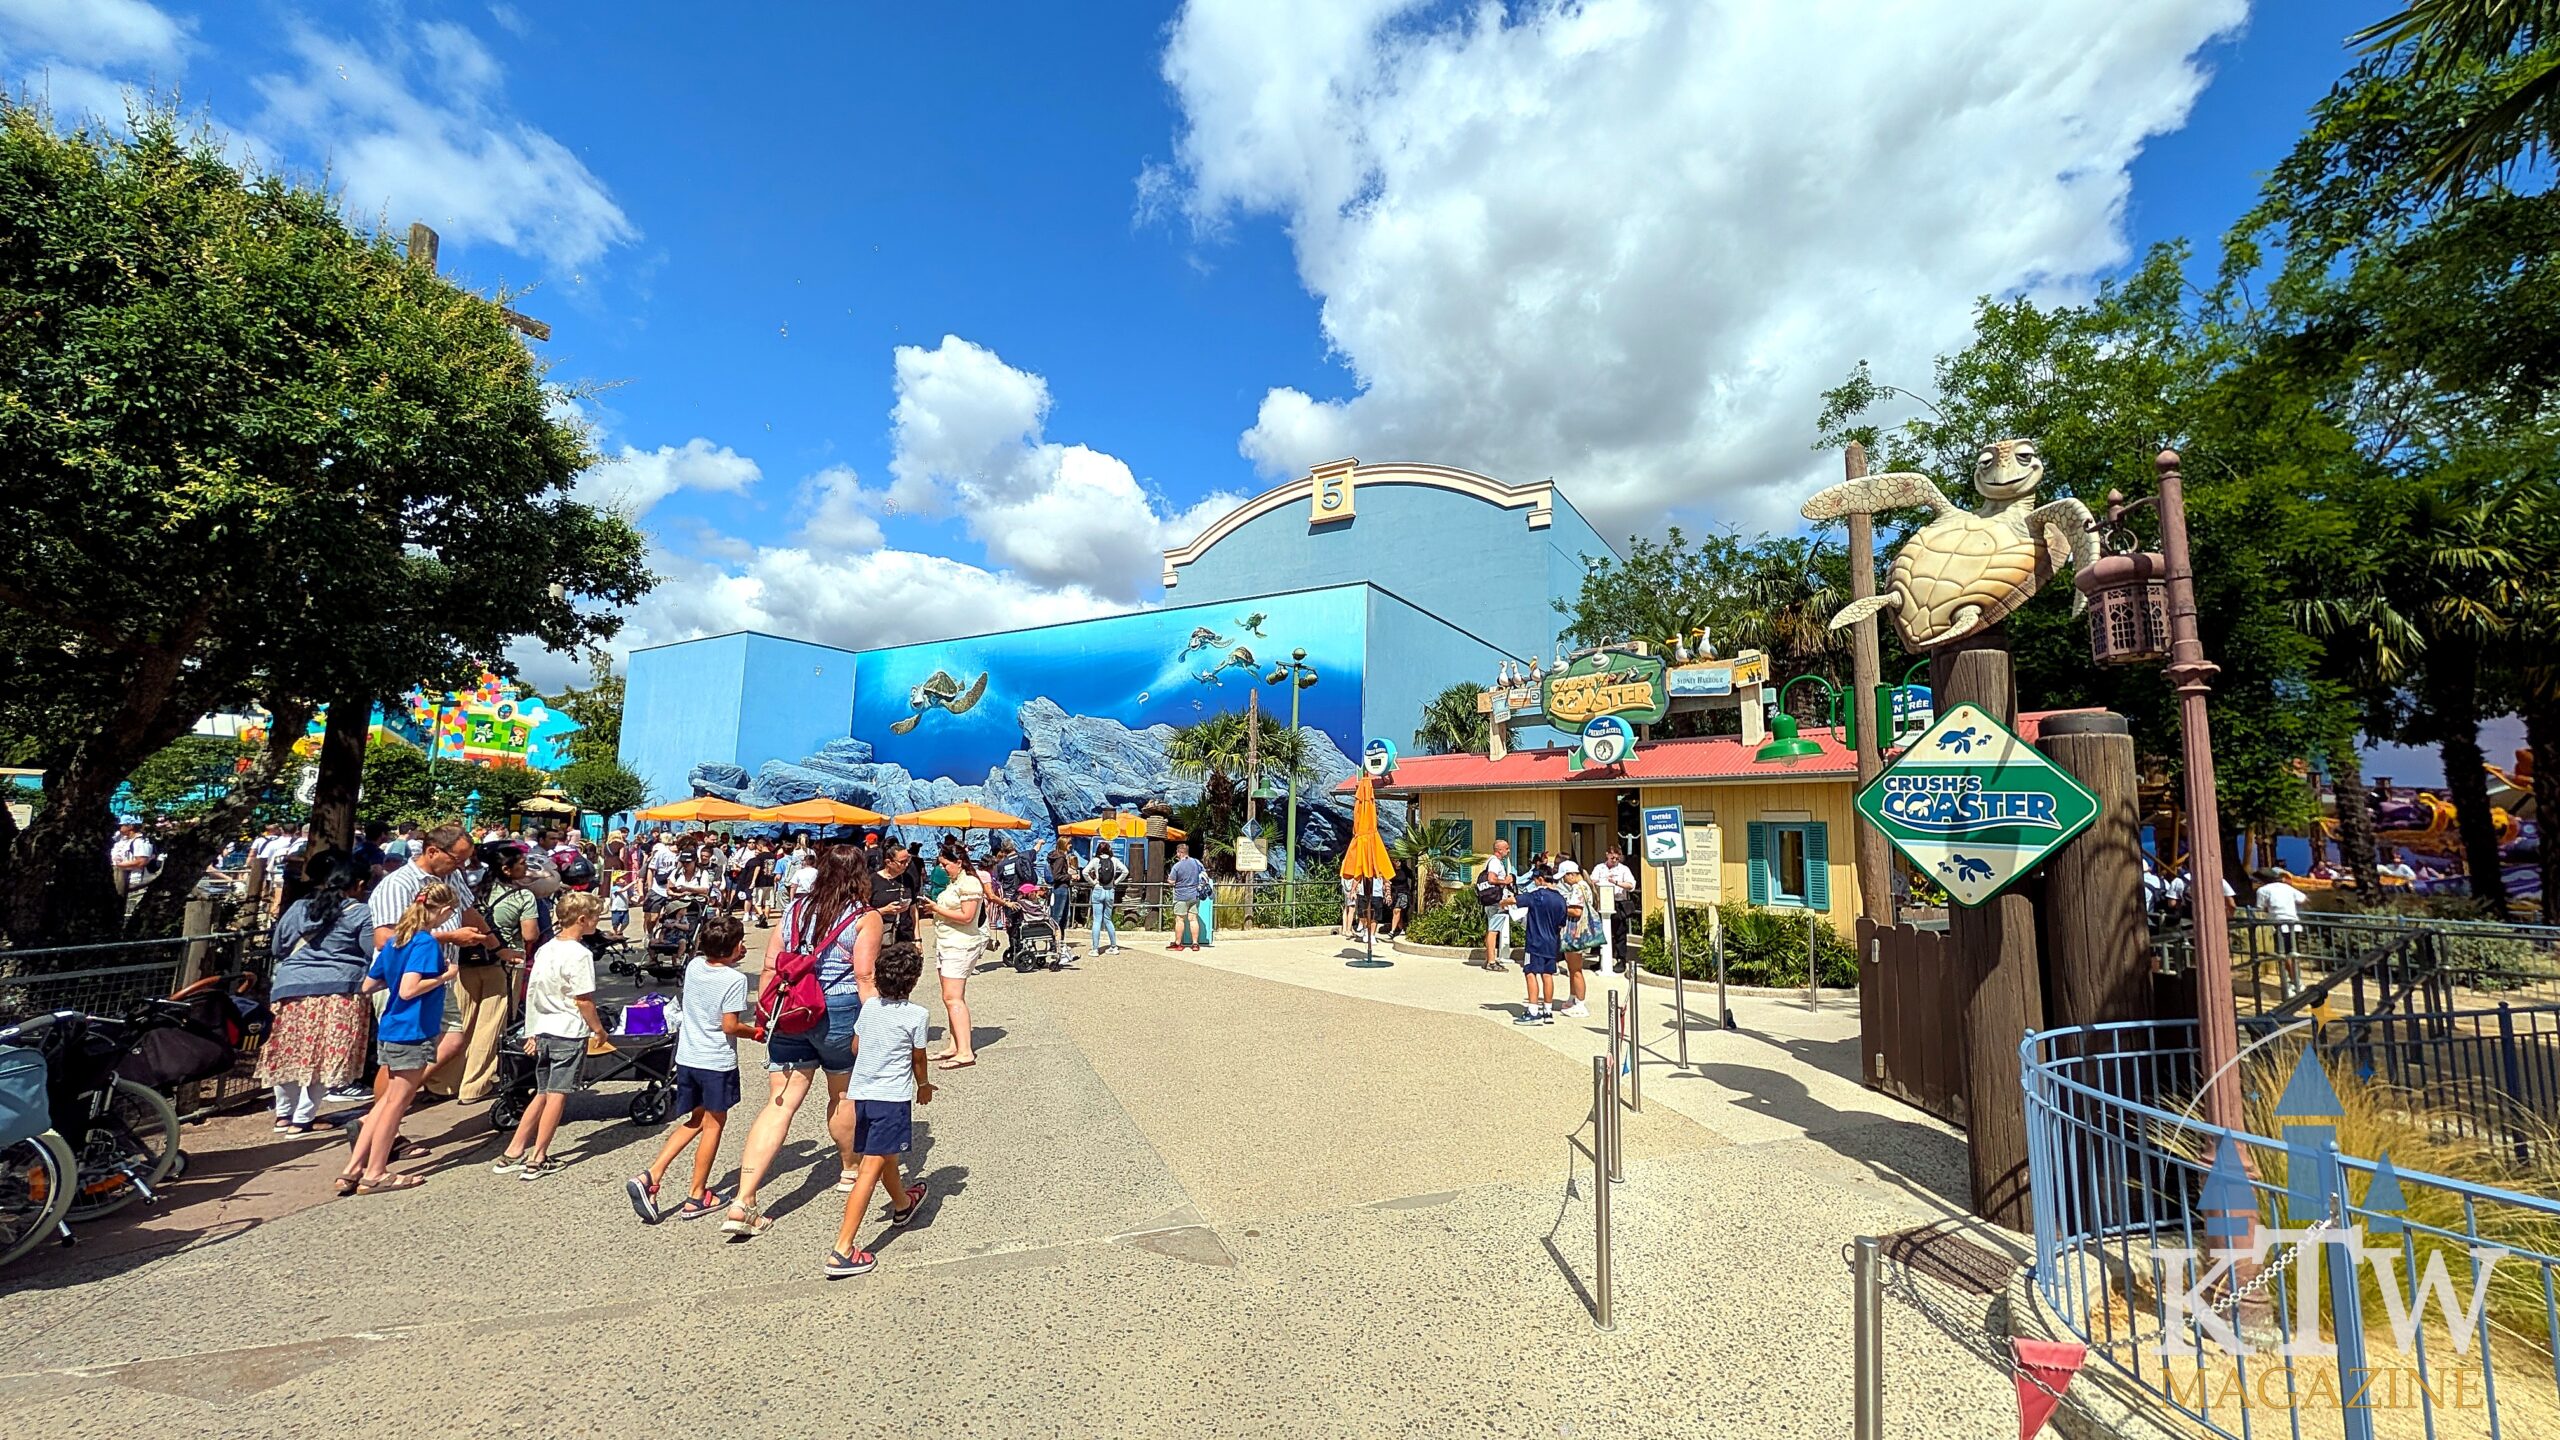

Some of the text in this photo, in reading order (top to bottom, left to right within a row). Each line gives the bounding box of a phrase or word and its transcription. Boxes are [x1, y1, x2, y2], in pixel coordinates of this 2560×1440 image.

[1322, 478, 1343, 511] 5
[1551, 682, 1655, 714] COASTER
[1893, 699, 1930, 714] NRÉE
[1884, 776, 1982, 792] CRUSH'S
[1883, 792, 2058, 824] COASTER
[1648, 823, 1677, 831] ENTRANCE
